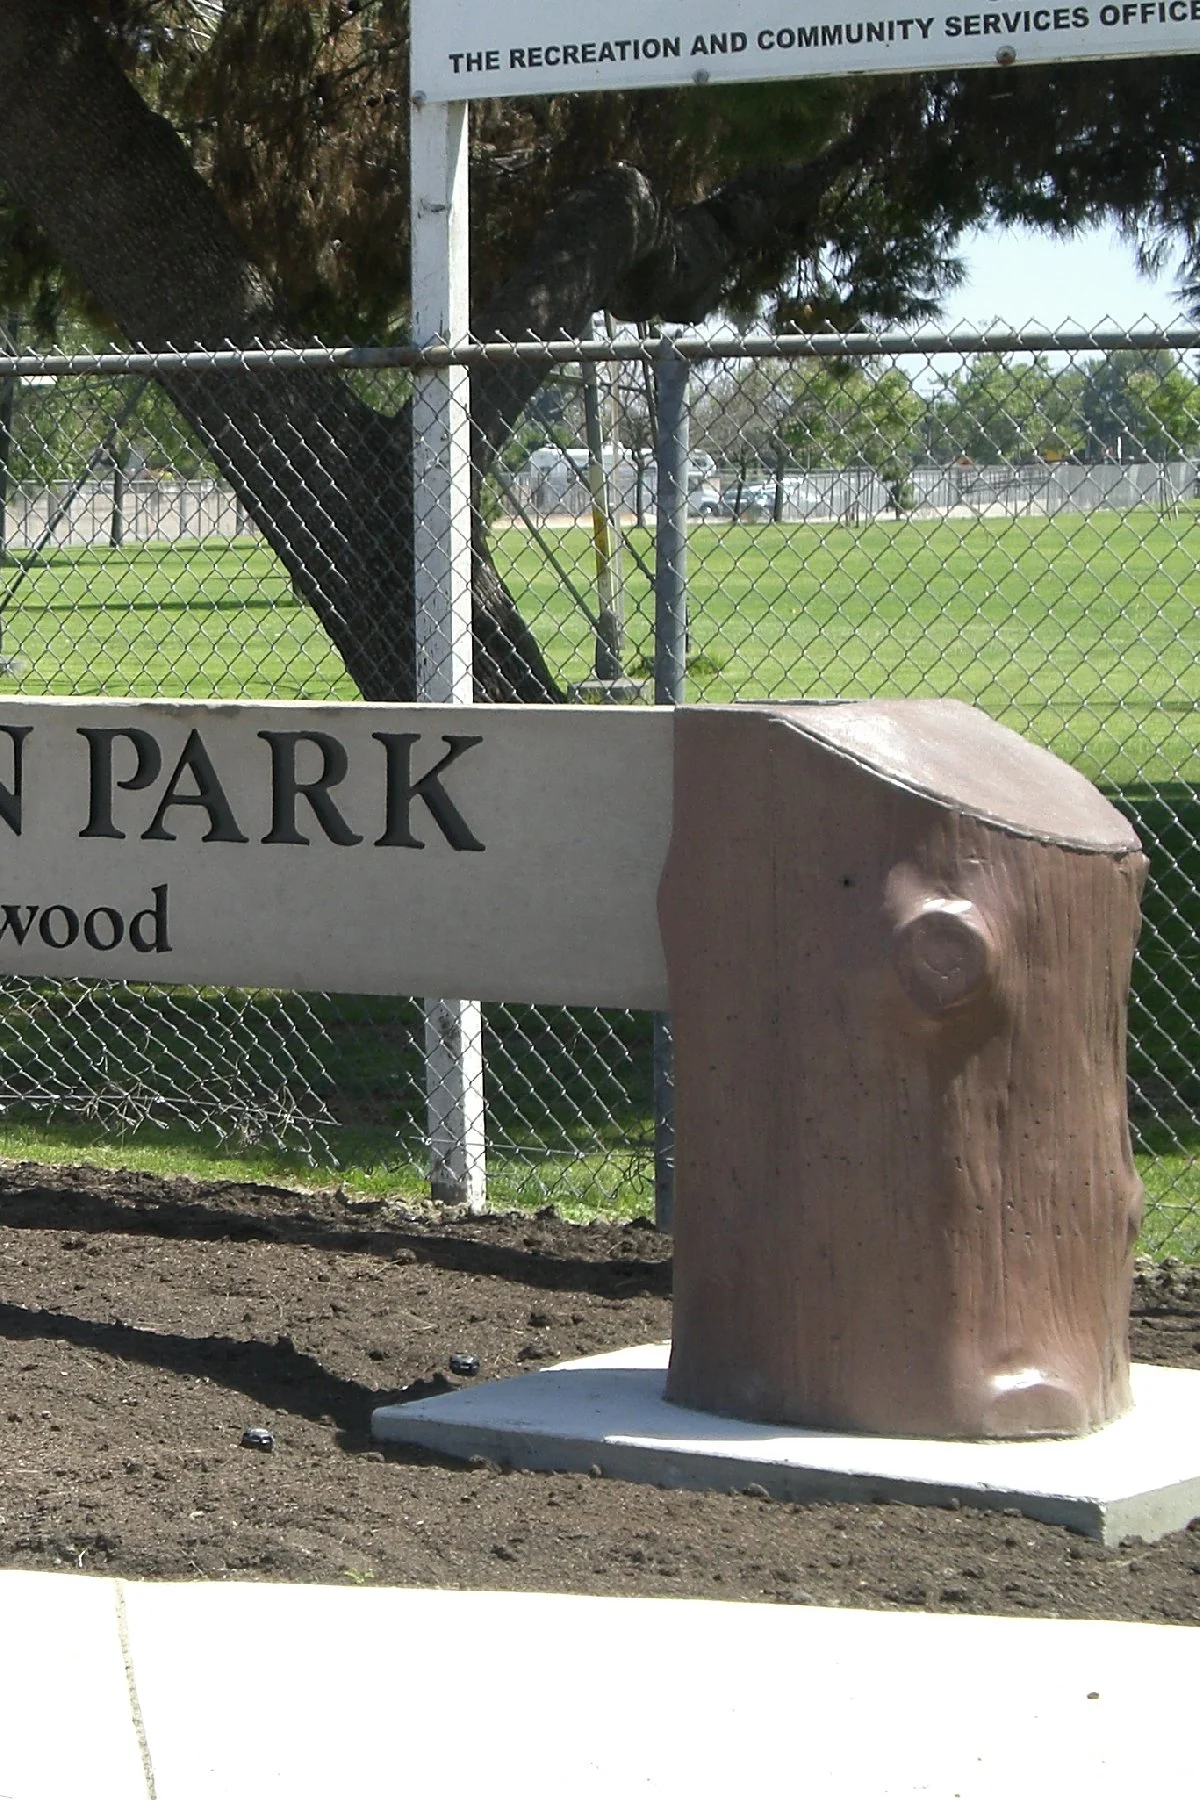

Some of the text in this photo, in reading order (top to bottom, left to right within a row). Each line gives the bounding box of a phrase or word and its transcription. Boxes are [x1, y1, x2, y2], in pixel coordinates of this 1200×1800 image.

[449, 50, 500, 74] THE
[509, 36, 681, 69] RECREATION
[689, 31, 748, 56] AND
[757, 17, 935, 51] COMMUNITY
[944, 6, 1090, 37] SERVICES
[75, 727, 486, 852] PARK
